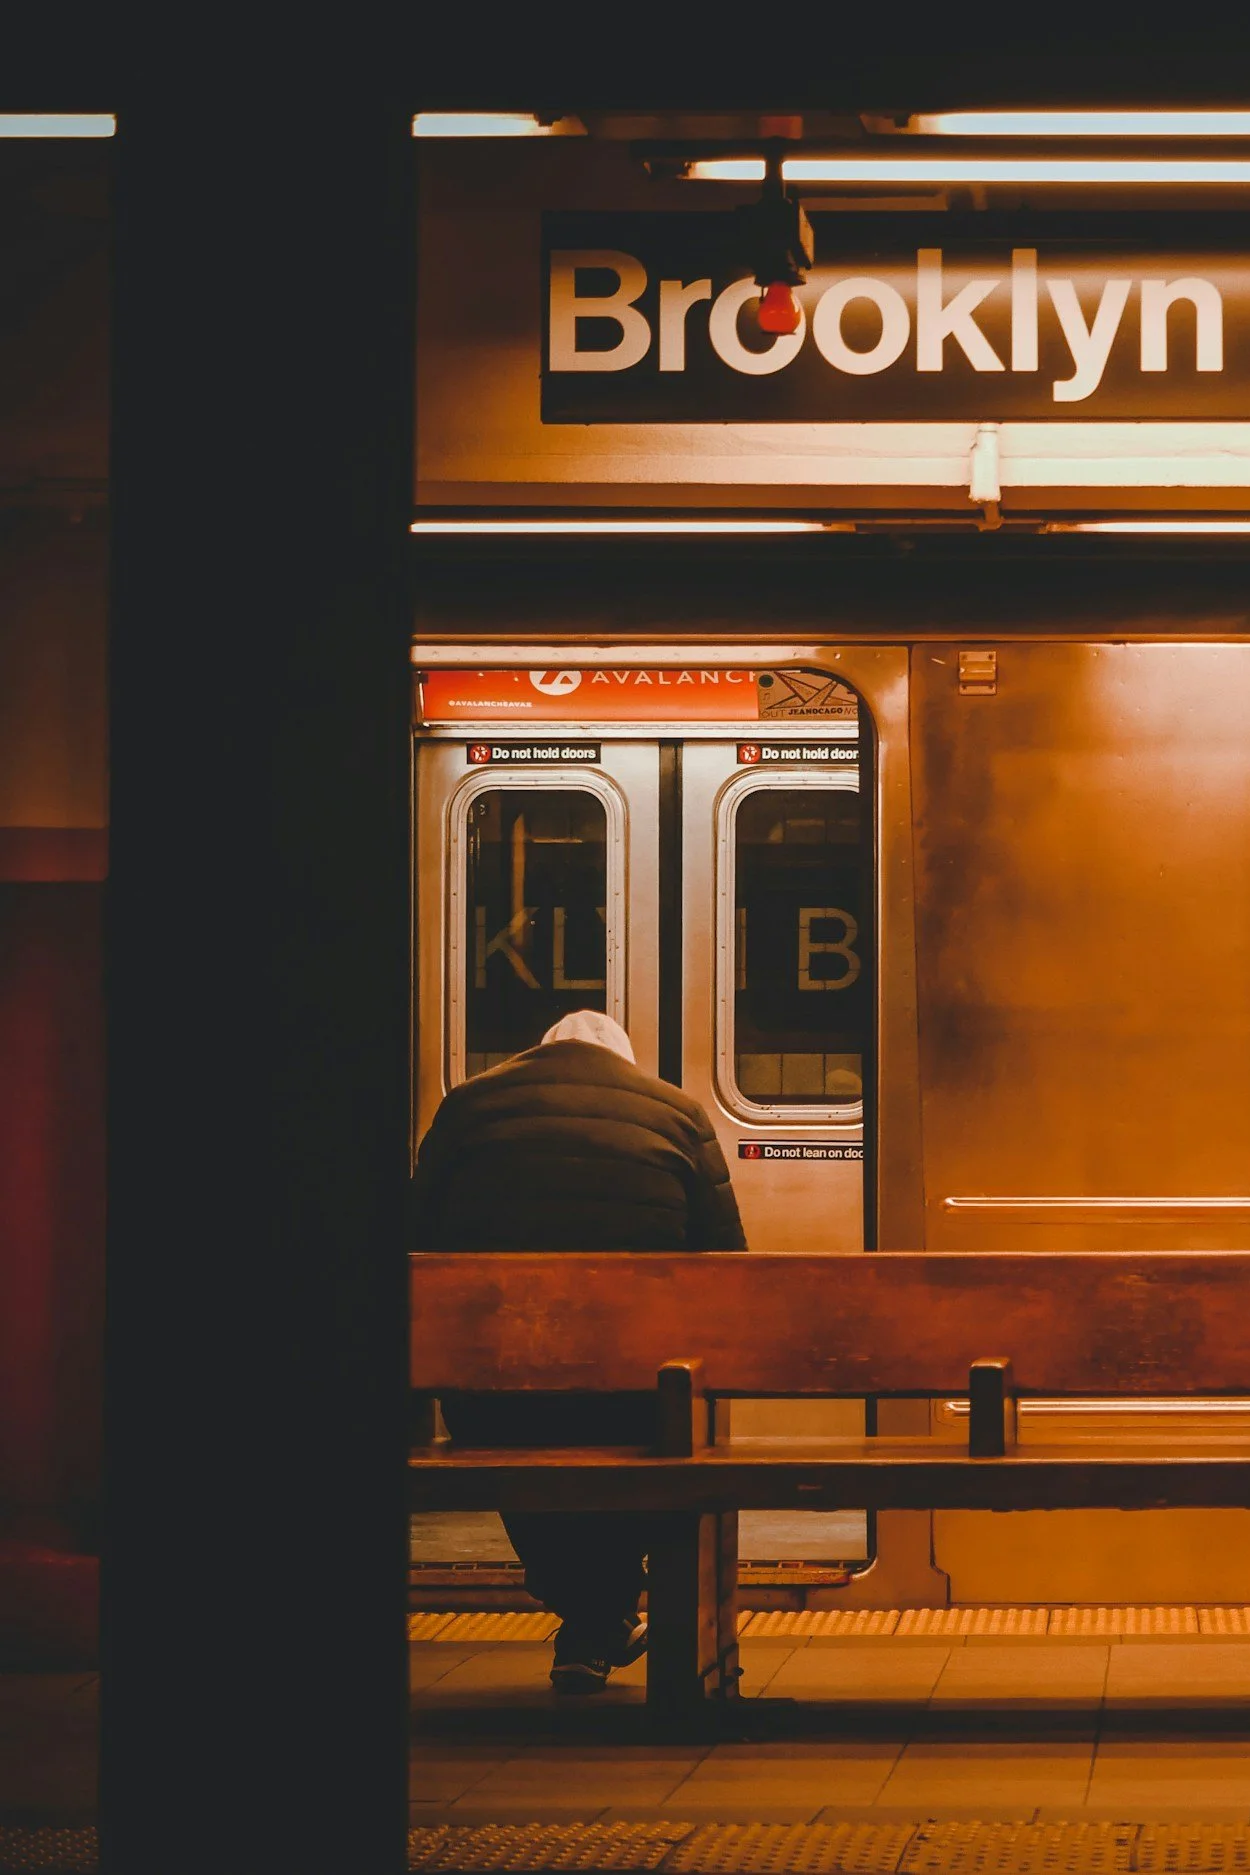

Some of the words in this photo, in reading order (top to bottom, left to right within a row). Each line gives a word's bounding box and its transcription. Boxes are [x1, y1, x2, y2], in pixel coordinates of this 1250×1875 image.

[548, 249, 1224, 402] Brooklyn
[492, 748, 510, 759] Do
[511, 748, 532, 759] not
[533, 747, 560, 759] hold
[561, 747, 597, 759] doors
[762, 748, 780, 759] Do
[781, 748, 801, 759] not
[803, 747, 829, 759] hold
[831, 748, 860, 760] door
[764, 1146, 781, 1157] Do
[782, 1147, 801, 1157] not
[803, 1147, 827, 1158] lean
[828, 1149, 842, 1158] on
